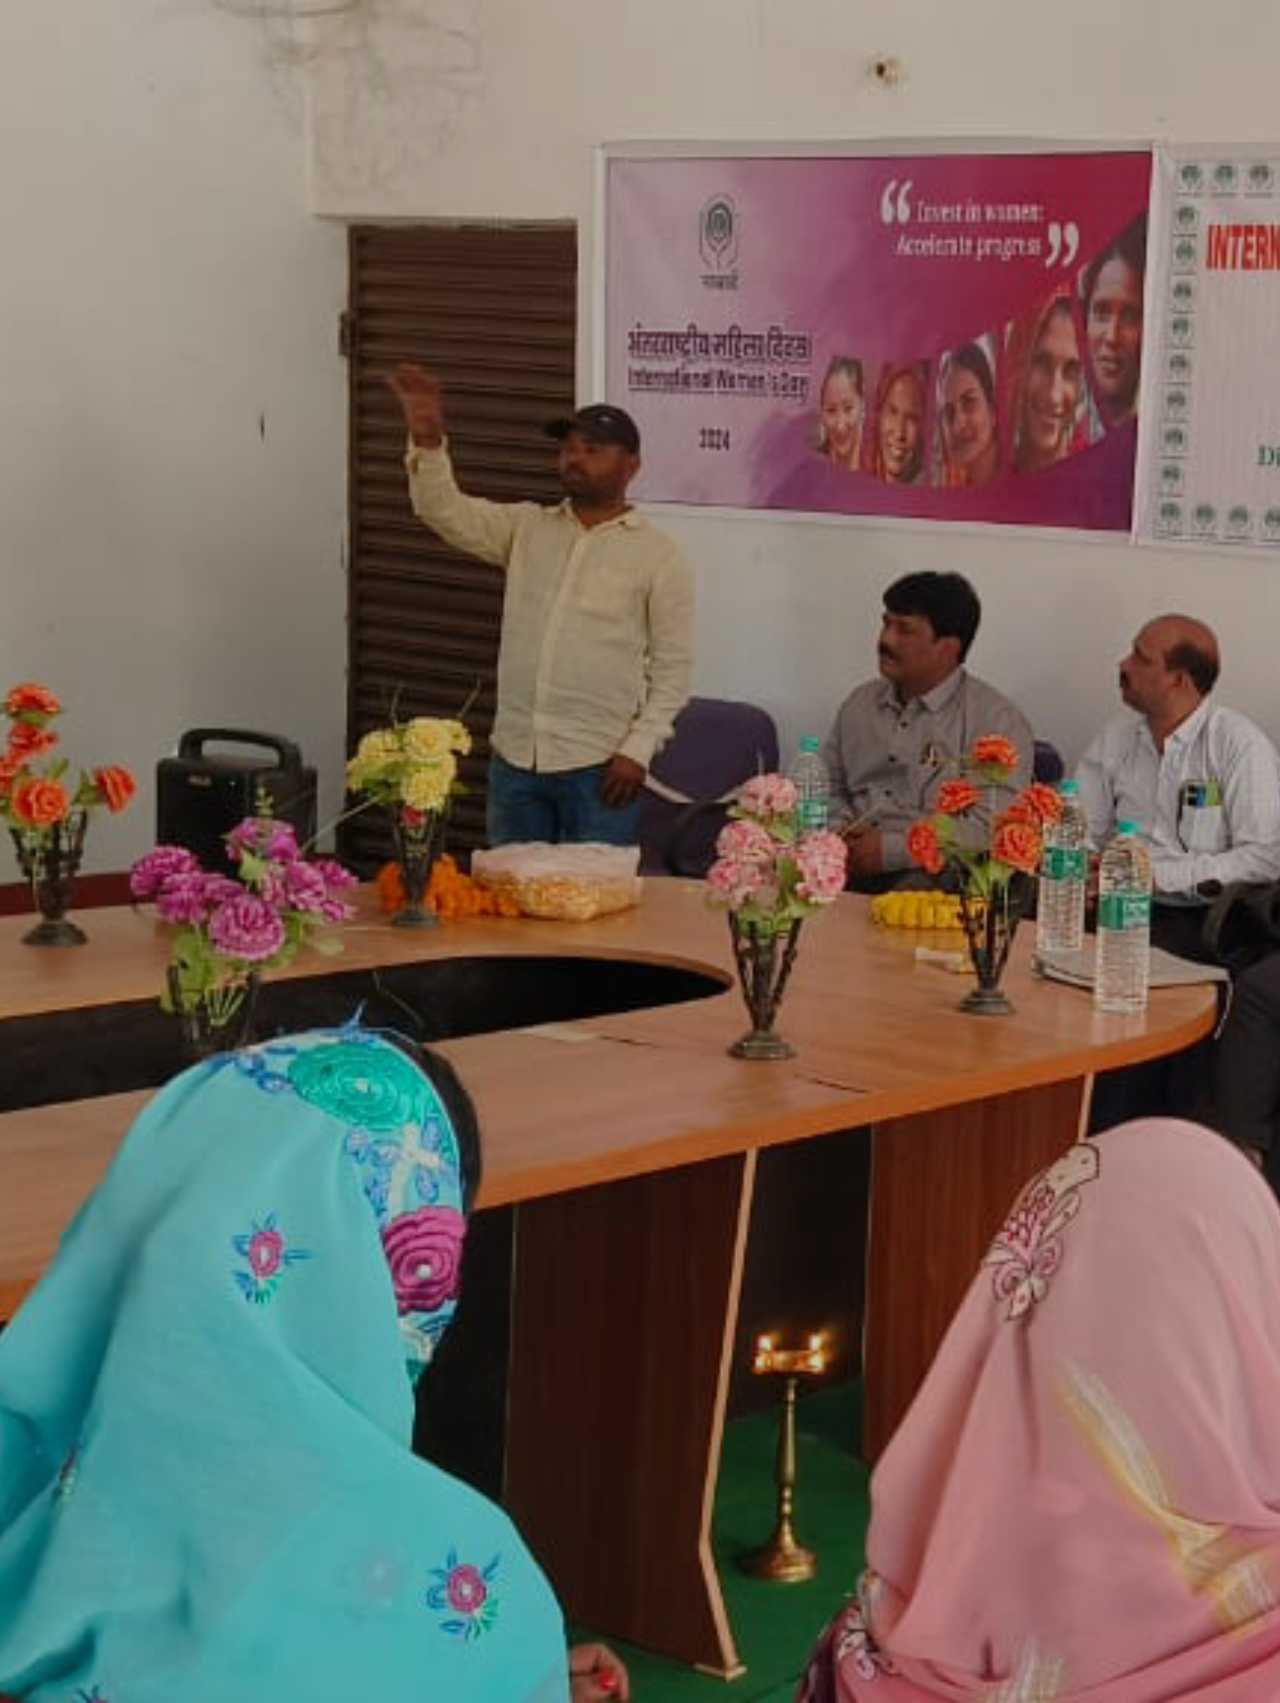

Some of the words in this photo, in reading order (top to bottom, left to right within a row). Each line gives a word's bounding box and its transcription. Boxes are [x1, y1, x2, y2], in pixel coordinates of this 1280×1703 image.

[917, 200, 960, 223] Invest
[964, 198, 982, 223] in
[897, 233, 972, 256] Accelerate
[976, 236, 1042, 262] progress
[713, 322, 764, 360] महिला
[628, 366, 712, 390] International
[781, 372, 807, 404] Day
[699, 427, 730, 451] 2024
